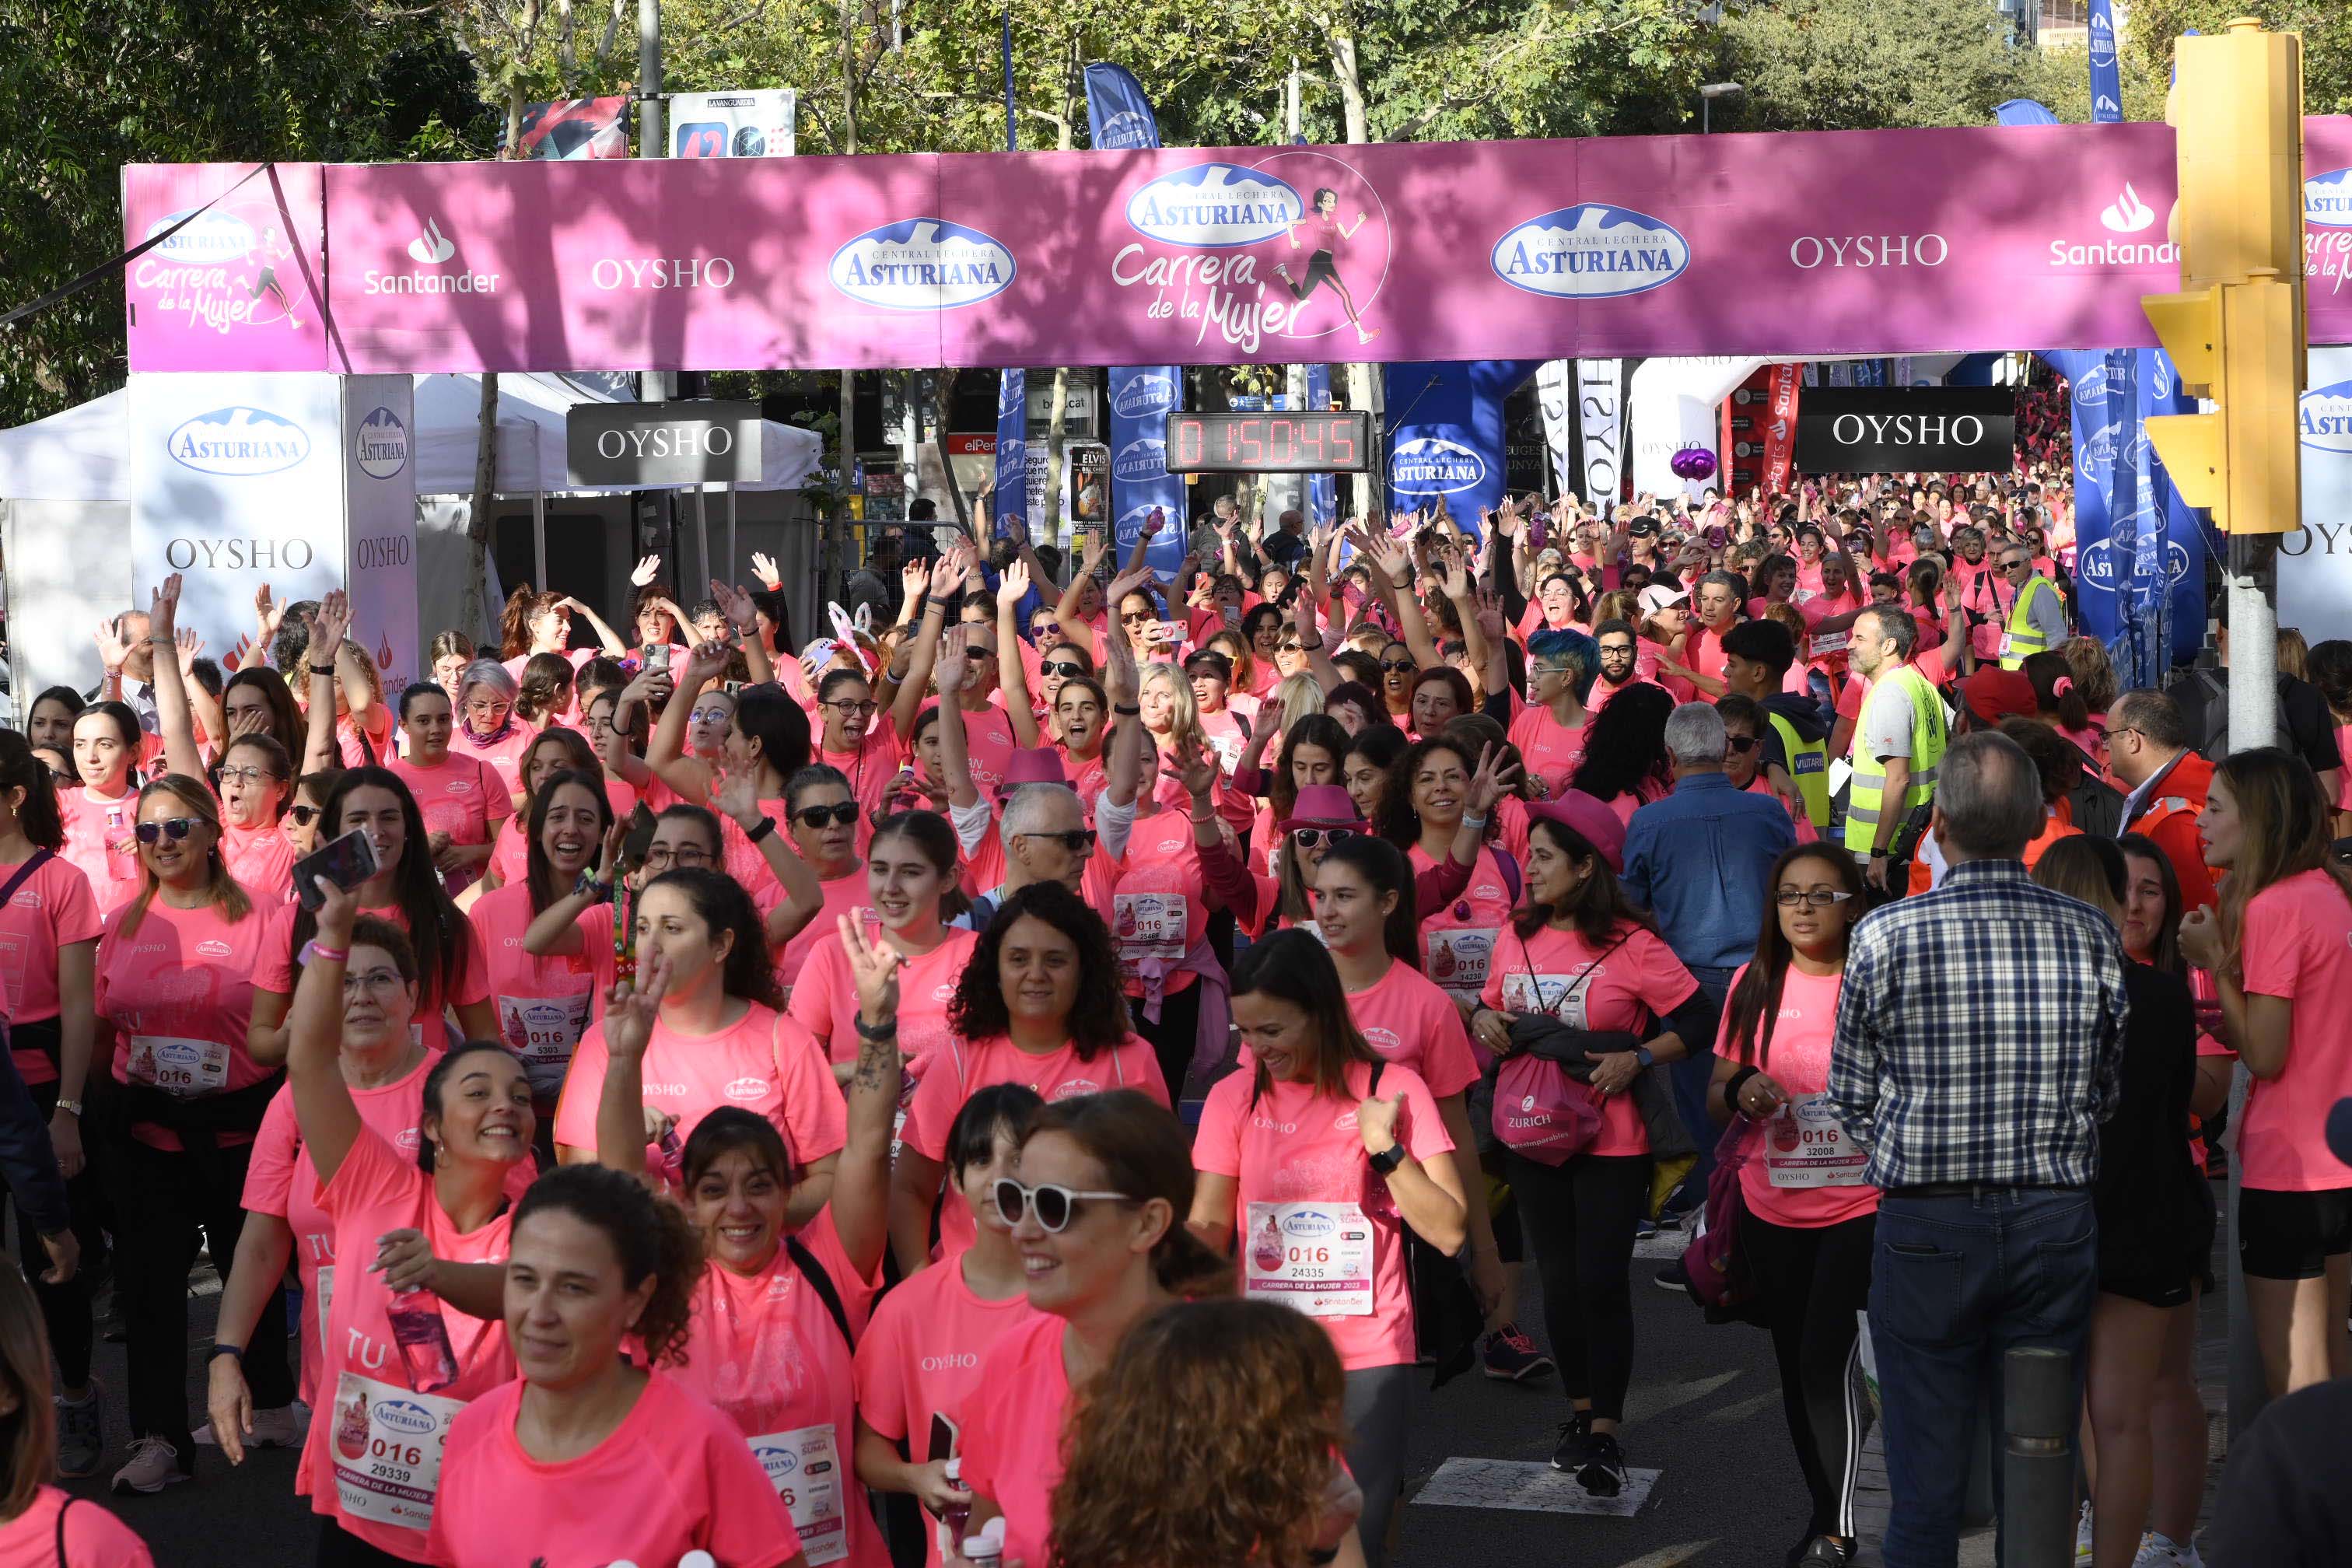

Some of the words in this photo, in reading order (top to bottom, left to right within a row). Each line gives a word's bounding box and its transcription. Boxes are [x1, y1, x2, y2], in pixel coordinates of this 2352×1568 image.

[1228, 191, 1284, 200] LECHERA
[1139, 196, 1290, 226] ASTURIANA
[156, 228, 247, 250] ASTURIANA
[1537, 236, 1599, 247] CENTRAL
[1605, 235, 1668, 245] LECHERA
[872, 250, 932, 260] CENTRAL
[936, 248, 996, 258] LECHERA
[1507, 239, 1675, 275] ASTURIANA
[1790, 234, 1948, 268] OYSHO
[2049, 239, 2181, 266] Santand
[592, 257, 735, 290] OYSHO
[845, 251, 1003, 287] ASTURIANA
[1111, 243, 1257, 286] Carrera
[135, 259, 229, 289] Carrera
[364, 270, 500, 296] Santander
[157, 293, 175, 310] de
[178, 295, 192, 311] la
[188, 286, 263, 334] Mujer
[1147, 289, 1174, 319] de
[1180, 287, 1200, 319] la
[1195, 282, 1312, 354] Mujer
[1043, 397, 1085, 410] b.cat
[1832, 414, 1984, 446] OYSHO
[179, 432, 299, 459] ASTURIANA
[359, 434, 404, 462] ASTURIANA
[597, 425, 733, 459] OYSHO
[964, 438, 997, 451] elPeri
[1082, 453, 1106, 464] ELVIS
[1390, 463, 1478, 482] ASTURIANA
[166, 538, 313, 569] OYSHO
[358, 534, 409, 570] OYSHO
[1137, 920, 1162, 931] 016
[198, 945, 231, 954] ASTURIANA
[504, 937, 523, 947] OYS
[1458, 959, 1486, 971] 016
[525, 1012, 565, 1022] ASTURIANA
[1776, 1009, 1801, 1019] SHO
[530, 1031, 564, 1043] 016
[159, 1049, 199, 1062] ASTURIANA
[537, 1046, 558, 1055] 5303
[159, 1069, 191, 1084] 016
[1508, 1114, 1552, 1128] ZURICH
[1802, 1129, 1839, 1143] 016
[1806, 1147, 1835, 1157] 32008
[1777, 1172, 1810, 1181] OYSHO
[1286, 1221, 1333, 1231] ASTURIANA
[1289, 1246, 1329, 1263] 016
[1291, 1268, 1325, 1278] 24335
[1324, 1297, 1363, 1306] Santander
[348, 1327, 387, 1369] TU
[921, 1353, 978, 1373] OYSHO
[378, 1406, 431, 1430] ASTURIANA
[371, 1438, 422, 1465] 016
[801, 1444, 828, 1456] SUMA
[370, 1462, 411, 1482] 29339
[337, 1468, 370, 1489] CARRERA
[370, 1481, 383, 1490] DE
[383, 1485, 397, 1494] LA
[397, 1487, 428, 1500] MUJER
[403, 1507, 432, 1521] Santa
